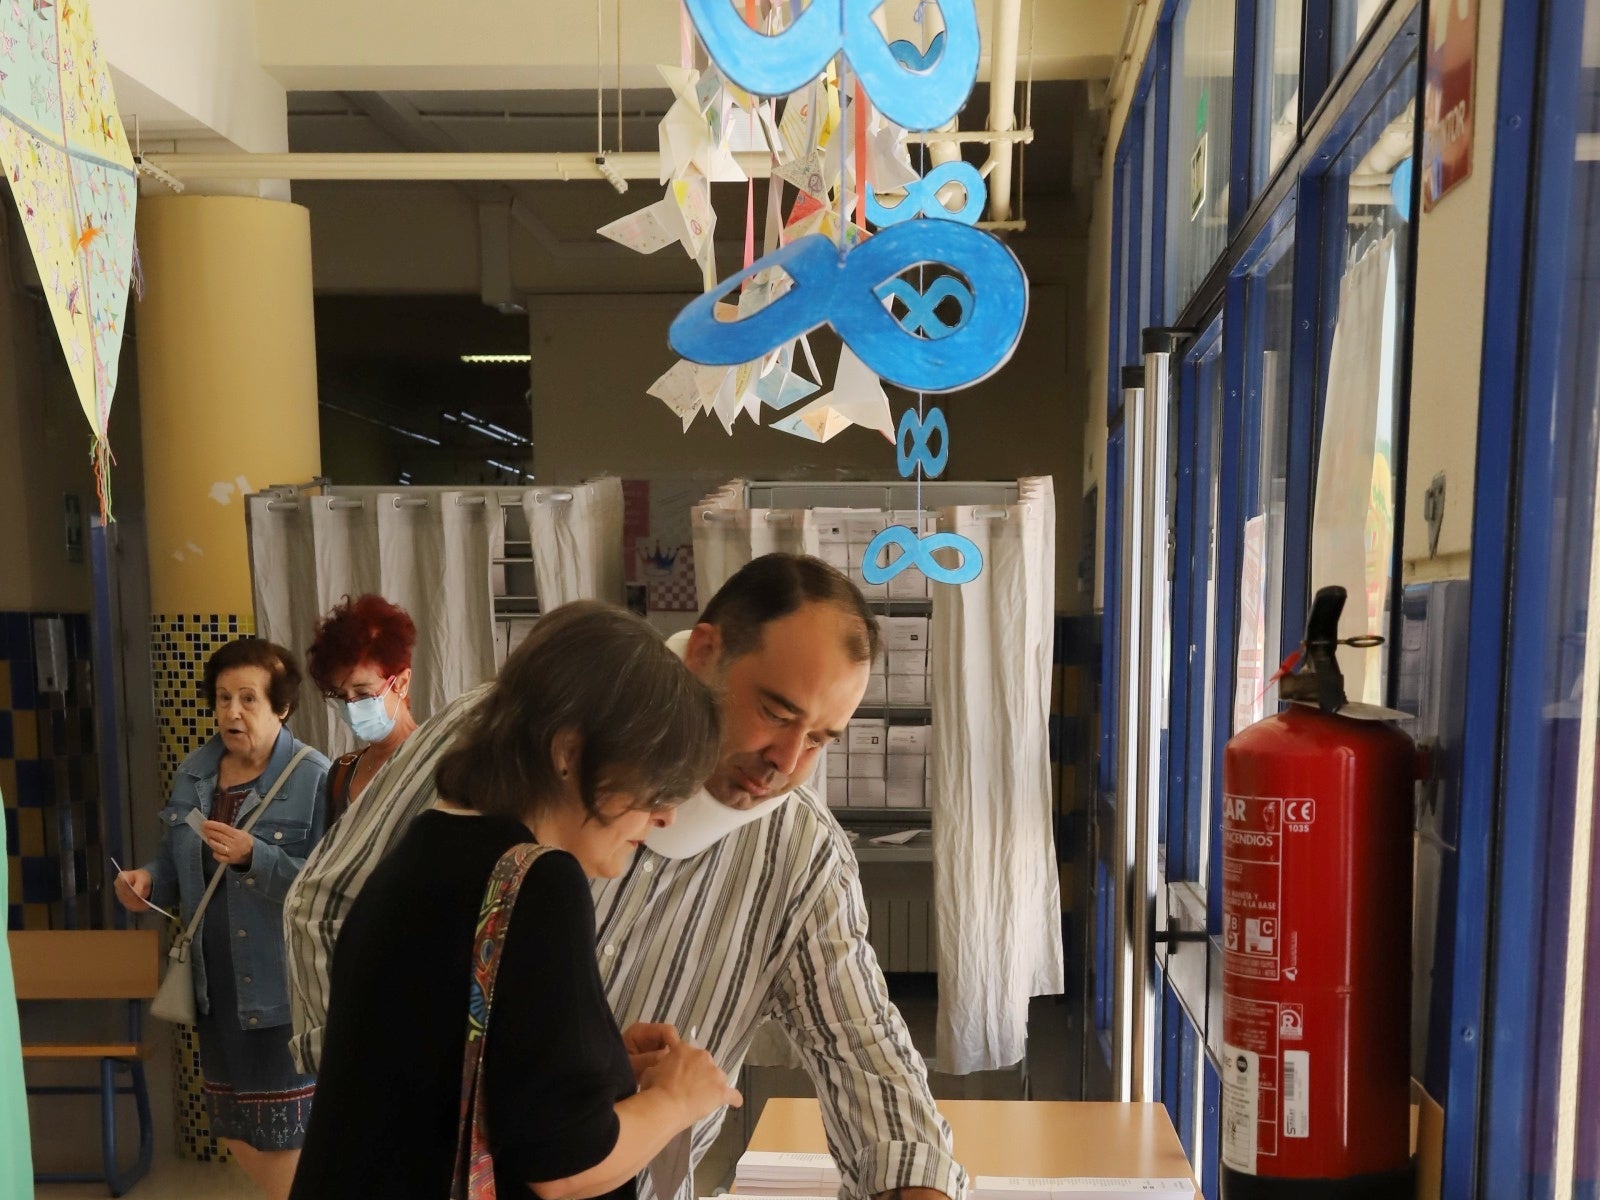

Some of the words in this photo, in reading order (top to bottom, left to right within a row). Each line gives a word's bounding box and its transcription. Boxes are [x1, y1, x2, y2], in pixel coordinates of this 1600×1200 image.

[1287, 801, 1312, 820] CE
[1288, 824, 1310, 833] 1035
[1262, 920, 1273, 934] C
